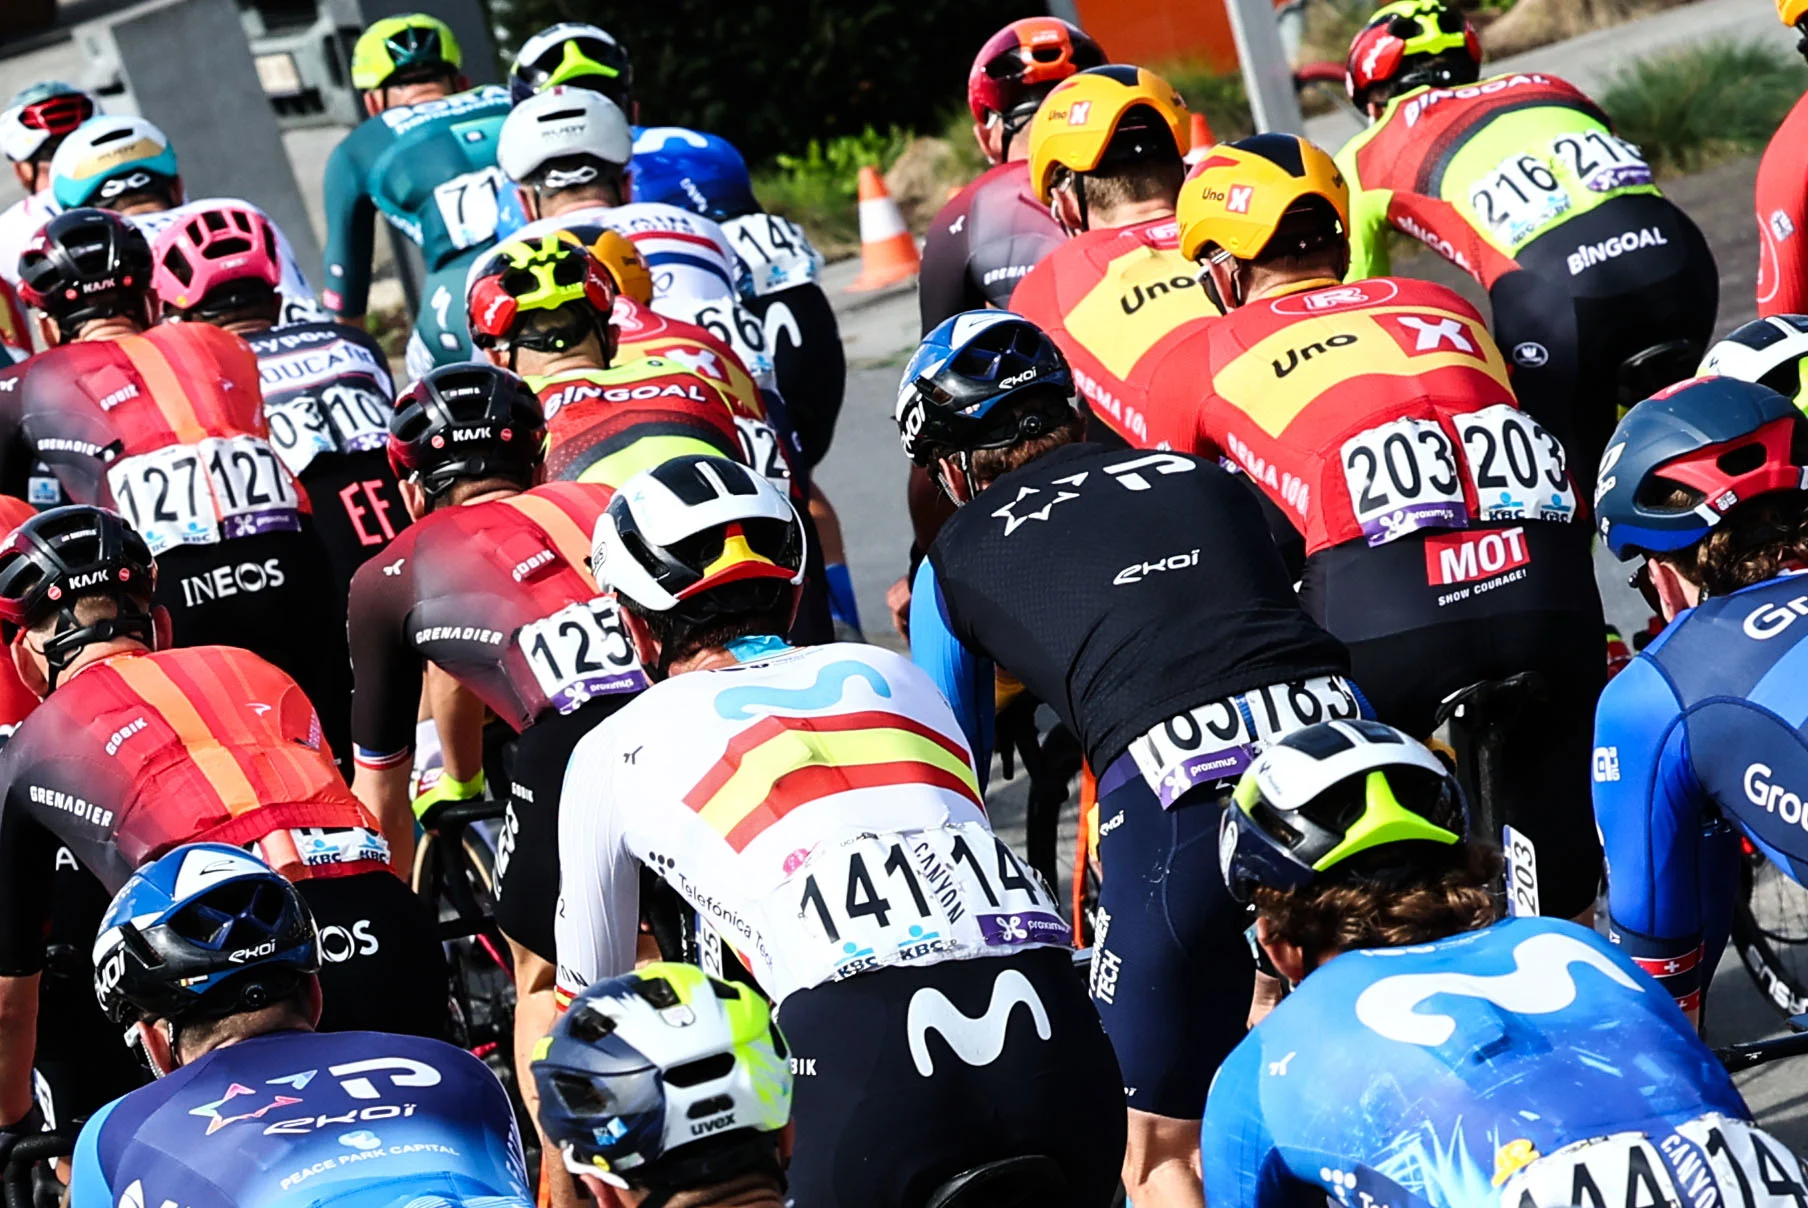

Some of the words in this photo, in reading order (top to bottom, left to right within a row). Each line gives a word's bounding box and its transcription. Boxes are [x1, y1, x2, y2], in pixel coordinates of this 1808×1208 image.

[1403, 74, 1550, 128] BINGOAL
[1202, 188, 1225, 201] Uno
[1472, 156, 1558, 227] 216
[1120, 275, 1197, 315] Uno
[1272, 334, 1358, 378] Uno
[1396, 316, 1474, 353] X
[544, 382, 707, 421] BINGOAL
[453, 427, 491, 442] KASK
[1464, 418, 1569, 492] 203
[118, 456, 197, 529] 127
[211, 447, 286, 508] 127
[1347, 430, 1458, 515] 203
[339, 479, 395, 546] EF
[68, 569, 110, 589] KASK
[511, 548, 556, 582] GOBIK
[1440, 527, 1525, 584] MOT
[181, 558, 285, 608] INEOS
[1437, 588, 1470, 607] SHOW
[1474, 568, 1527, 594] COURAGE!
[414, 625, 503, 646] GRENADIER
[530, 611, 633, 681] 125
[590, 678, 634, 694] proximus
[104, 718, 148, 756] GOBIK
[1190, 756, 1237, 776] proximus
[28, 785, 113, 828] GRENADIER
[307, 849, 342, 867] KBC
[358, 846, 390, 864] KBC
[1517, 843, 1536, 915] 203
[679, 872, 752, 938] Telefónica
[800, 844, 931, 944] 141
[914, 842, 965, 925] CANYON
[836, 956, 880, 980] KBC
[900, 939, 942, 962] KBC
[1096, 952, 1123, 1005] TECH
[690, 1112, 737, 1136] uvex
[280, 1159, 336, 1190] PEACE
[339, 1149, 386, 1165] PARK
[390, 1145, 460, 1157] CAPITAL
